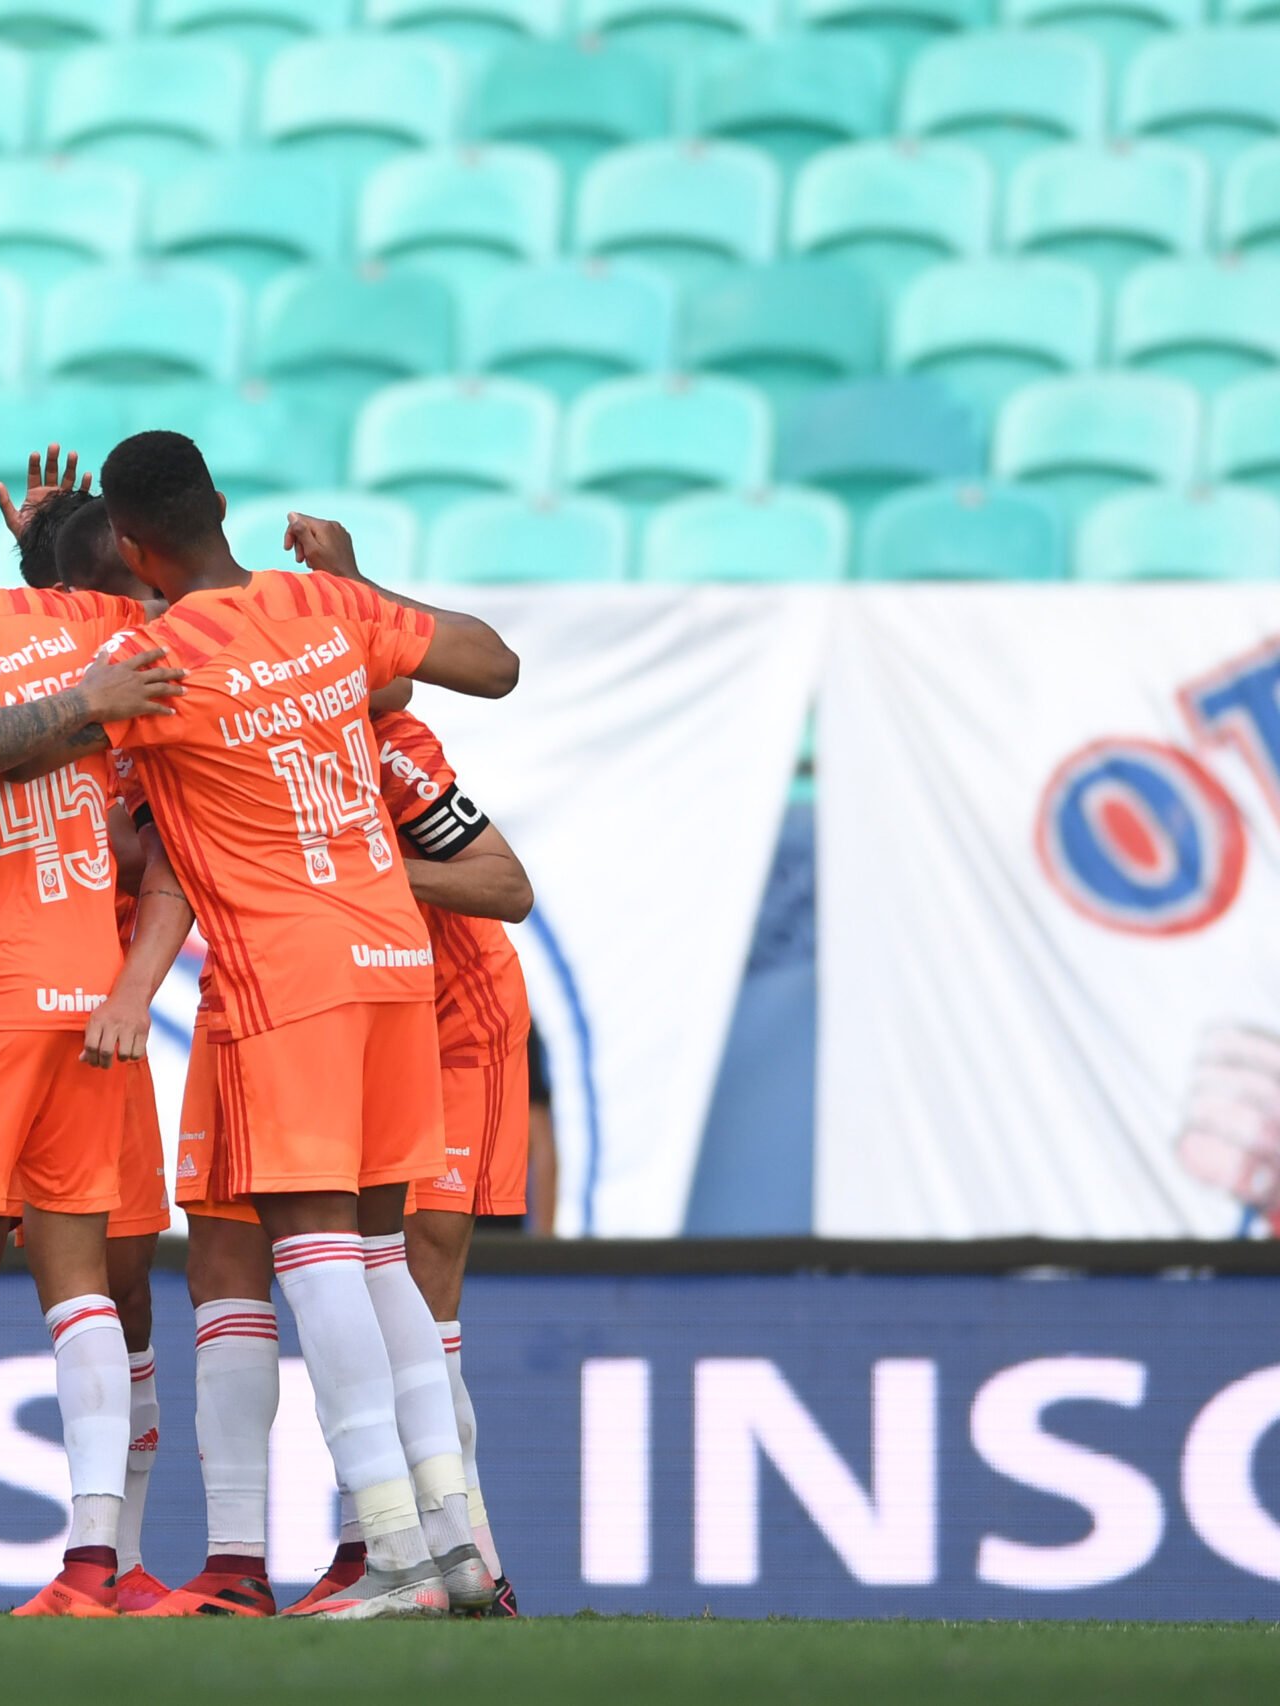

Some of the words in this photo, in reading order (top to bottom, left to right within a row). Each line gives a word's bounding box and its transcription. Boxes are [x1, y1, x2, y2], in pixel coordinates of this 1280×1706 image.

[250, 626, 350, 687] Banrisul
[219, 697, 303, 747] LUCAS
[380, 741, 439, 800] vero
[268, 719, 393, 885] 14
